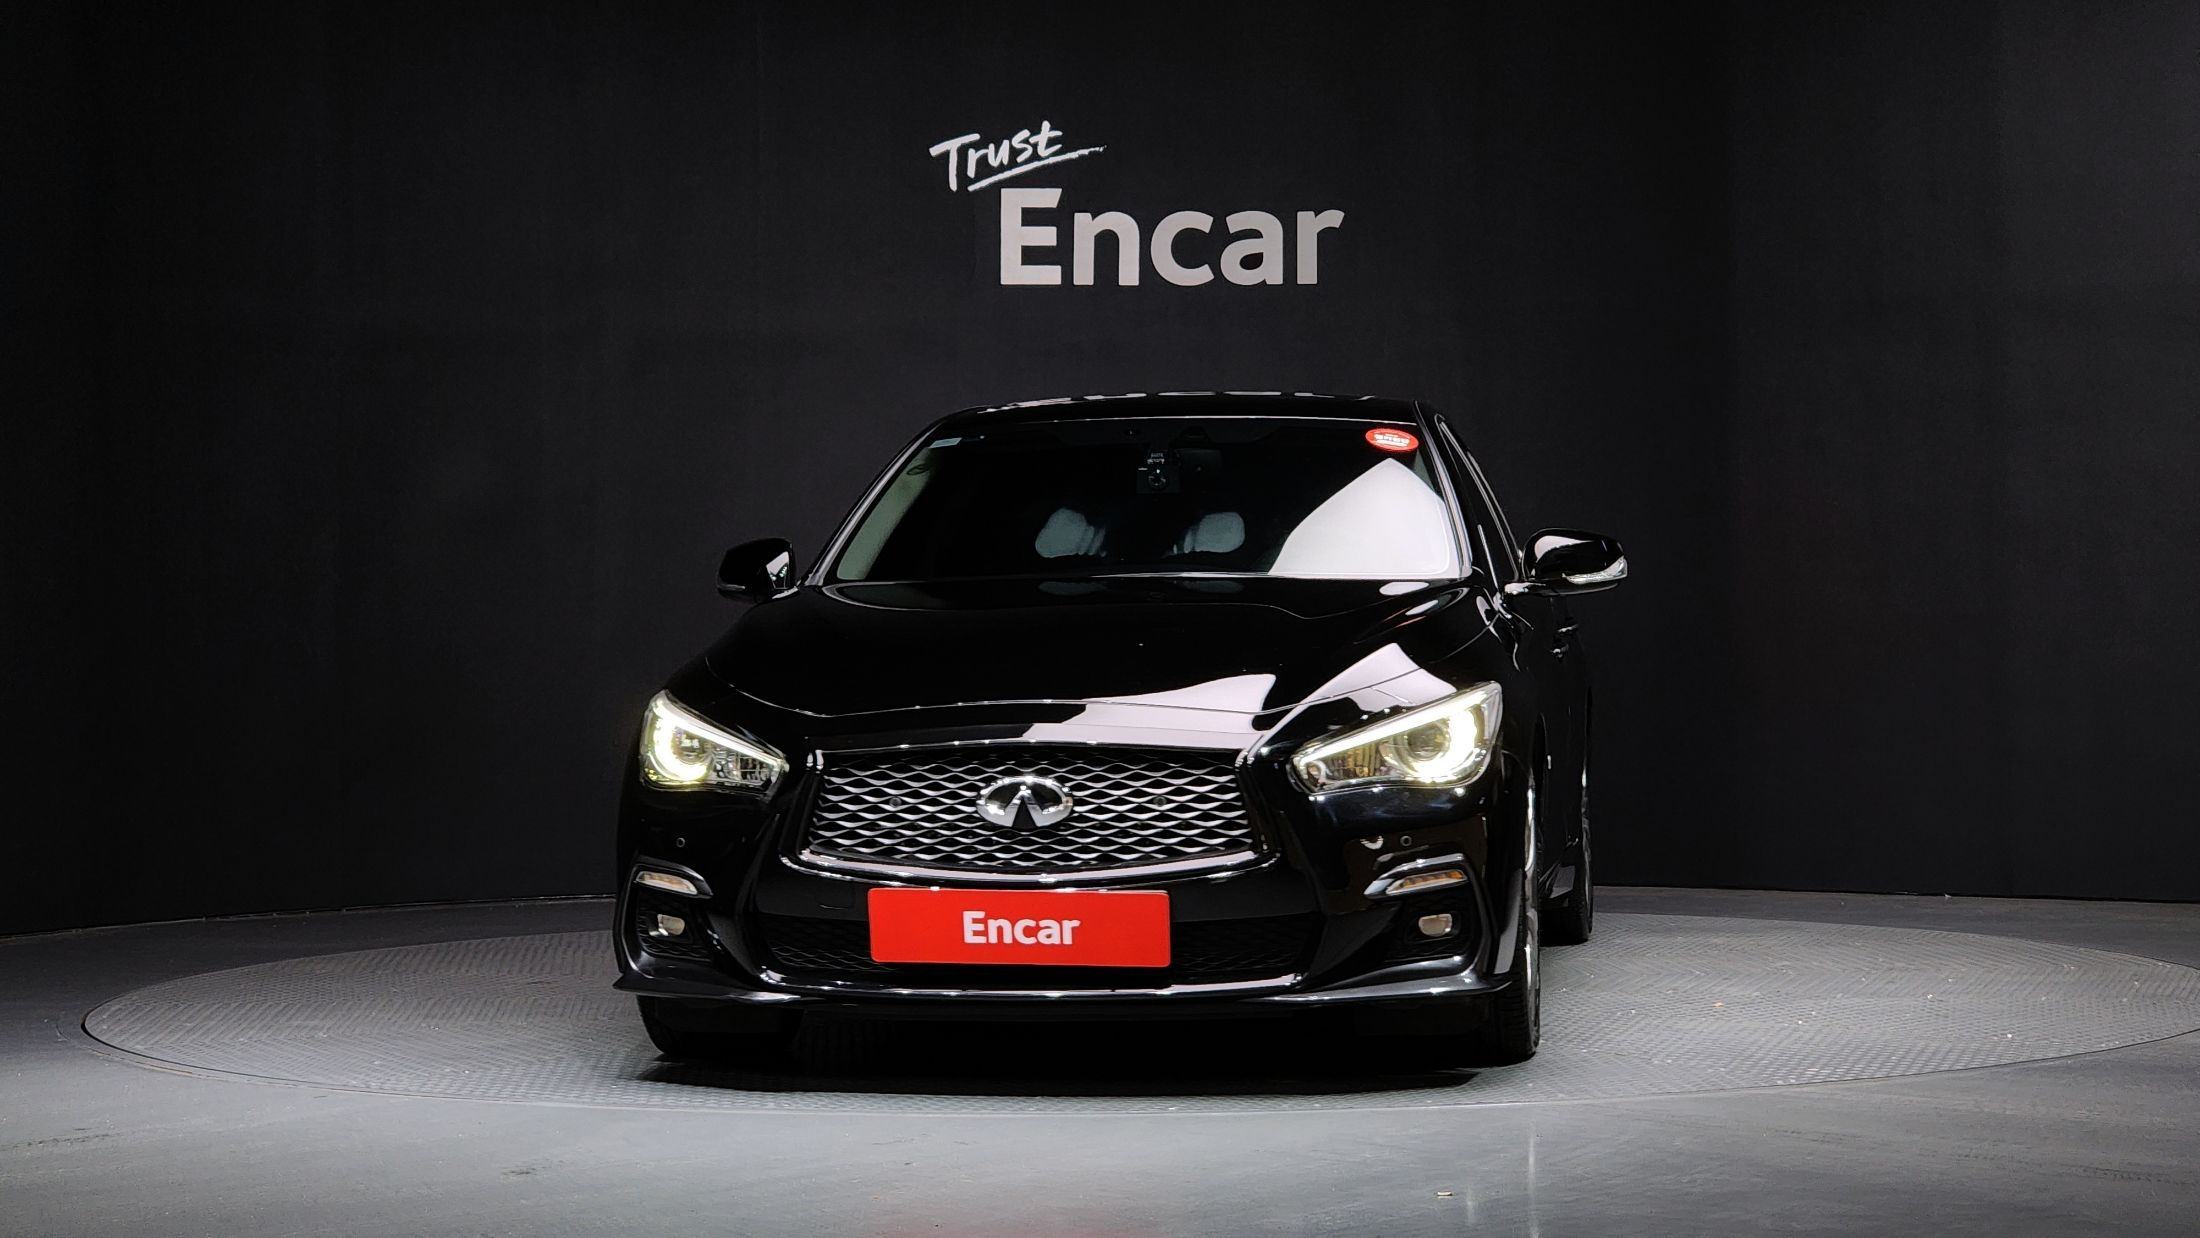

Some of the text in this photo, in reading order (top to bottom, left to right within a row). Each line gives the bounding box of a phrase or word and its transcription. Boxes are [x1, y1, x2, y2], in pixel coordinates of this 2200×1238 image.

[929, 120, 1064, 193] Trust
[999, 187, 1346, 287] Encar
[962, 910, 1081, 945] Encar
